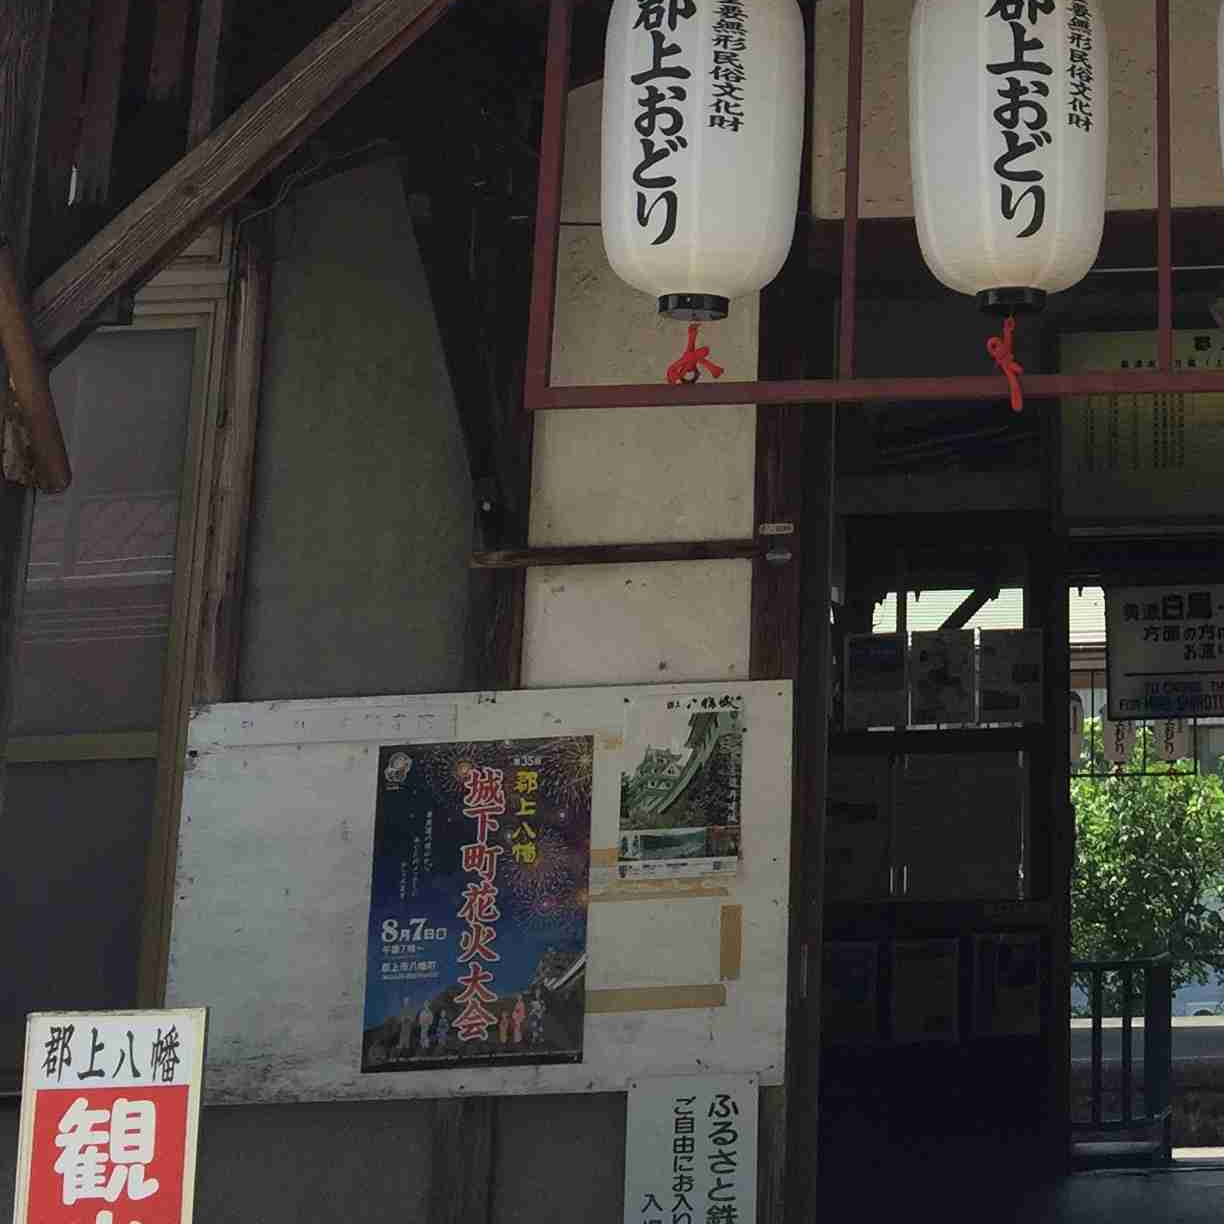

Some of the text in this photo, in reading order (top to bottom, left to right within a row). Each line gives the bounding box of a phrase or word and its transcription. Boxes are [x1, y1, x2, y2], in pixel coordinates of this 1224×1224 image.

[511, 770, 539, 864] 郡上八幡
[452, 766, 506, 1043] 城下町花火大会
[41, 1023, 181, 1083] 郡上八幡
[53, 1096, 160, 1224] 観
[640, 1193, 664, 1224] 入
